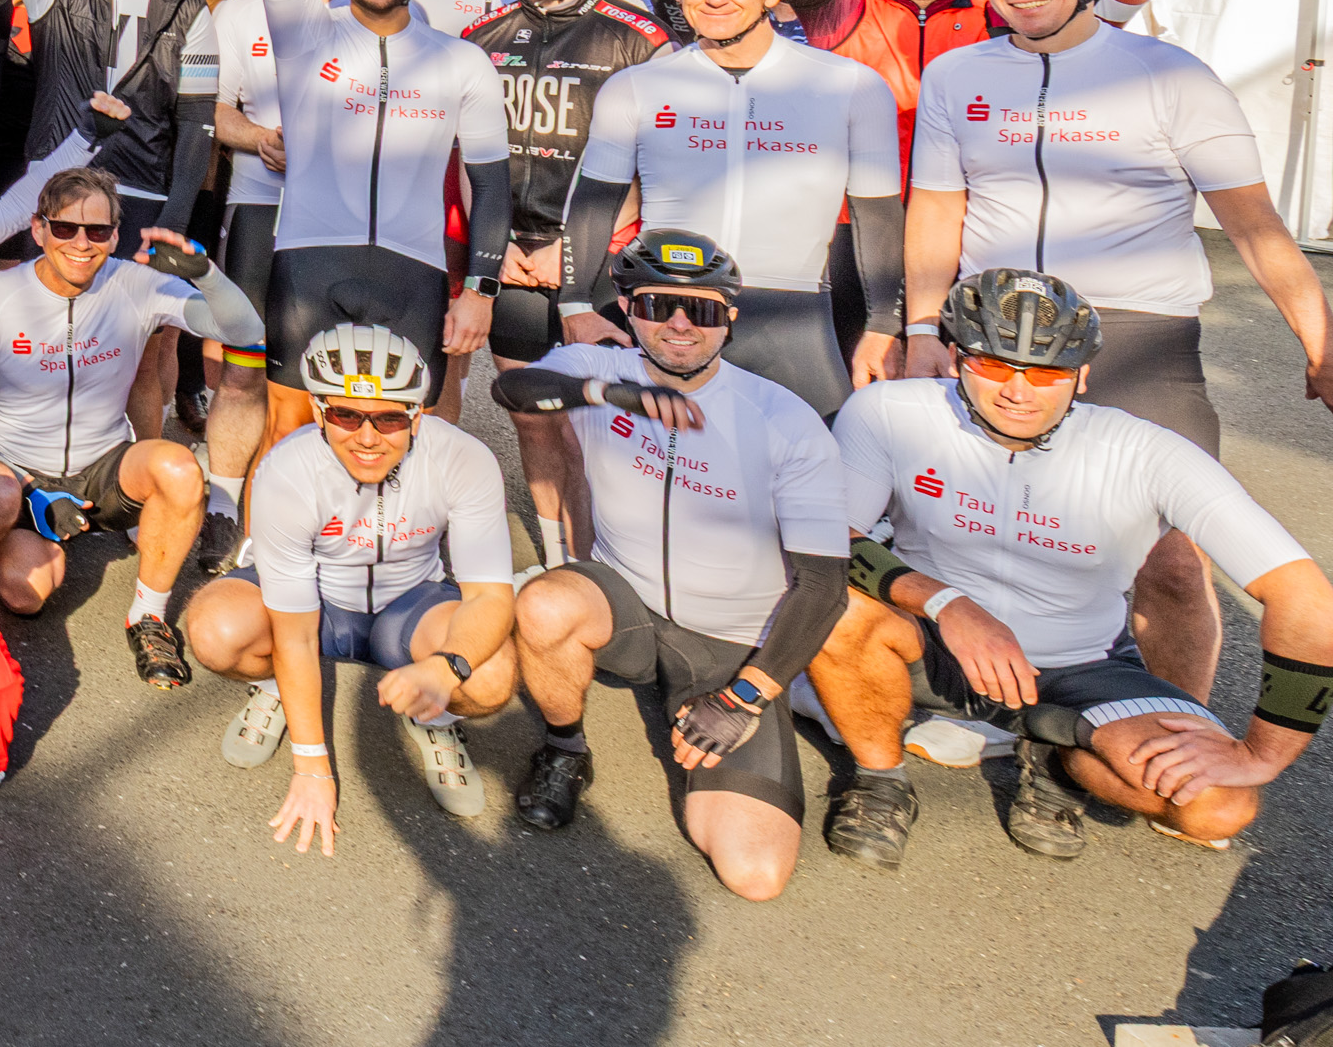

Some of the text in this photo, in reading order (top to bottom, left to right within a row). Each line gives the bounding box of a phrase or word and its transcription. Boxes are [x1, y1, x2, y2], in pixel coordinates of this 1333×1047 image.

[600, 3, 657, 35] rose.de
[475, 251, 503, 261] MAAP
[562, 235, 575, 285] RYZON
